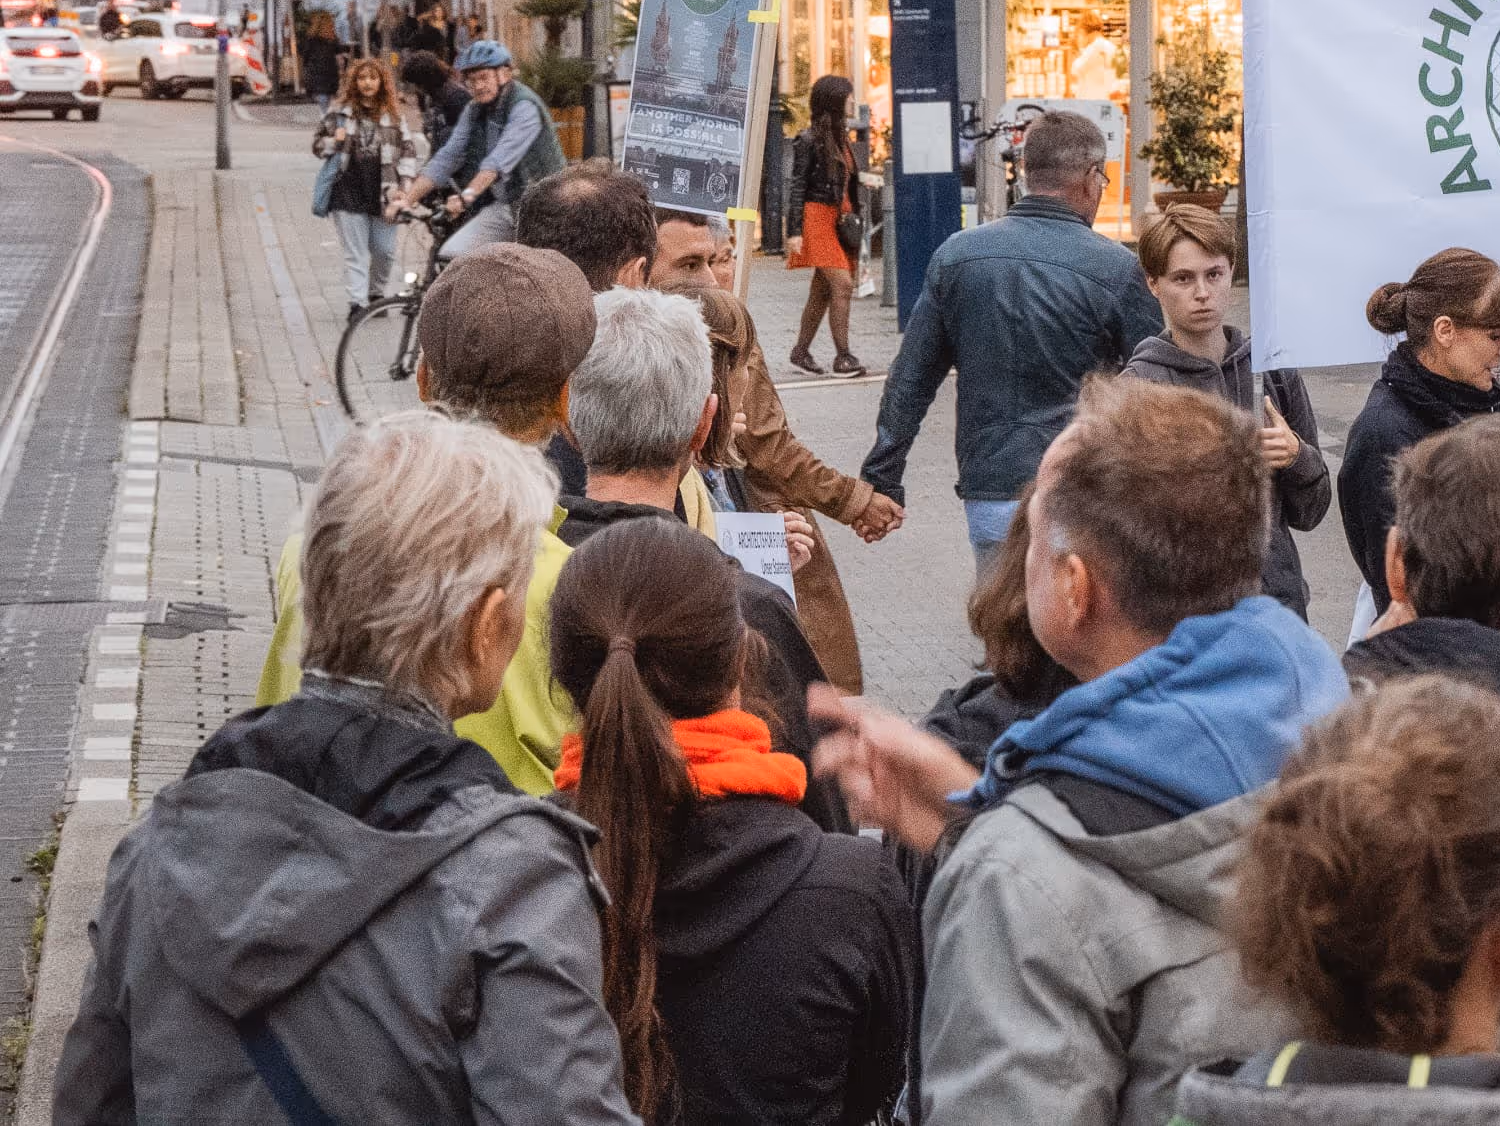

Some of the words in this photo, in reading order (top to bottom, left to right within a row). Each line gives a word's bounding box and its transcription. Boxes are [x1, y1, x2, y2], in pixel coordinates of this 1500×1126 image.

[636, 107, 692, 124] ANOTHER
[695, 116, 737, 132] WORLD
[666, 125, 724, 144] POSSIBLE
